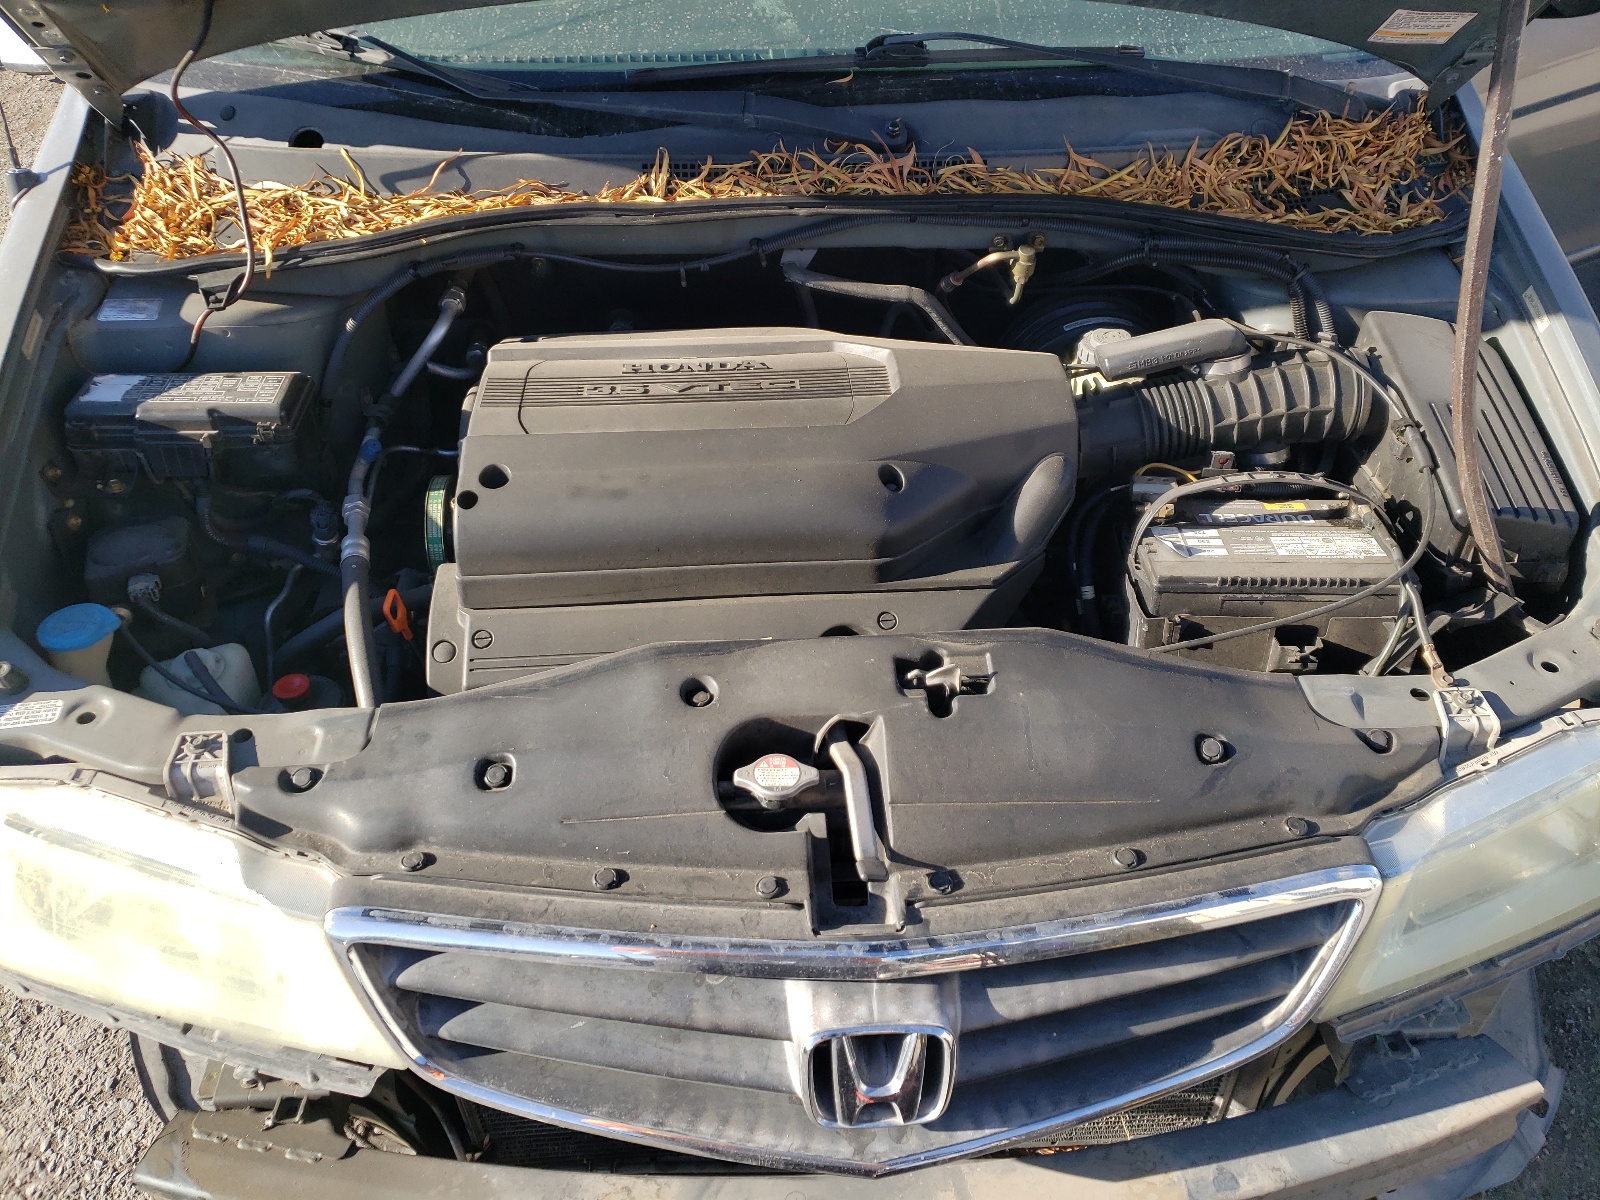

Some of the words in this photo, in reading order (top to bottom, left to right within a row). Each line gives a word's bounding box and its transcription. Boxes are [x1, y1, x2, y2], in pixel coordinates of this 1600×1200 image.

[621, 360, 773, 374] HONDA
[659, 379, 799, 393] VTEC
[1198, 513, 1315, 524] DURACELL
